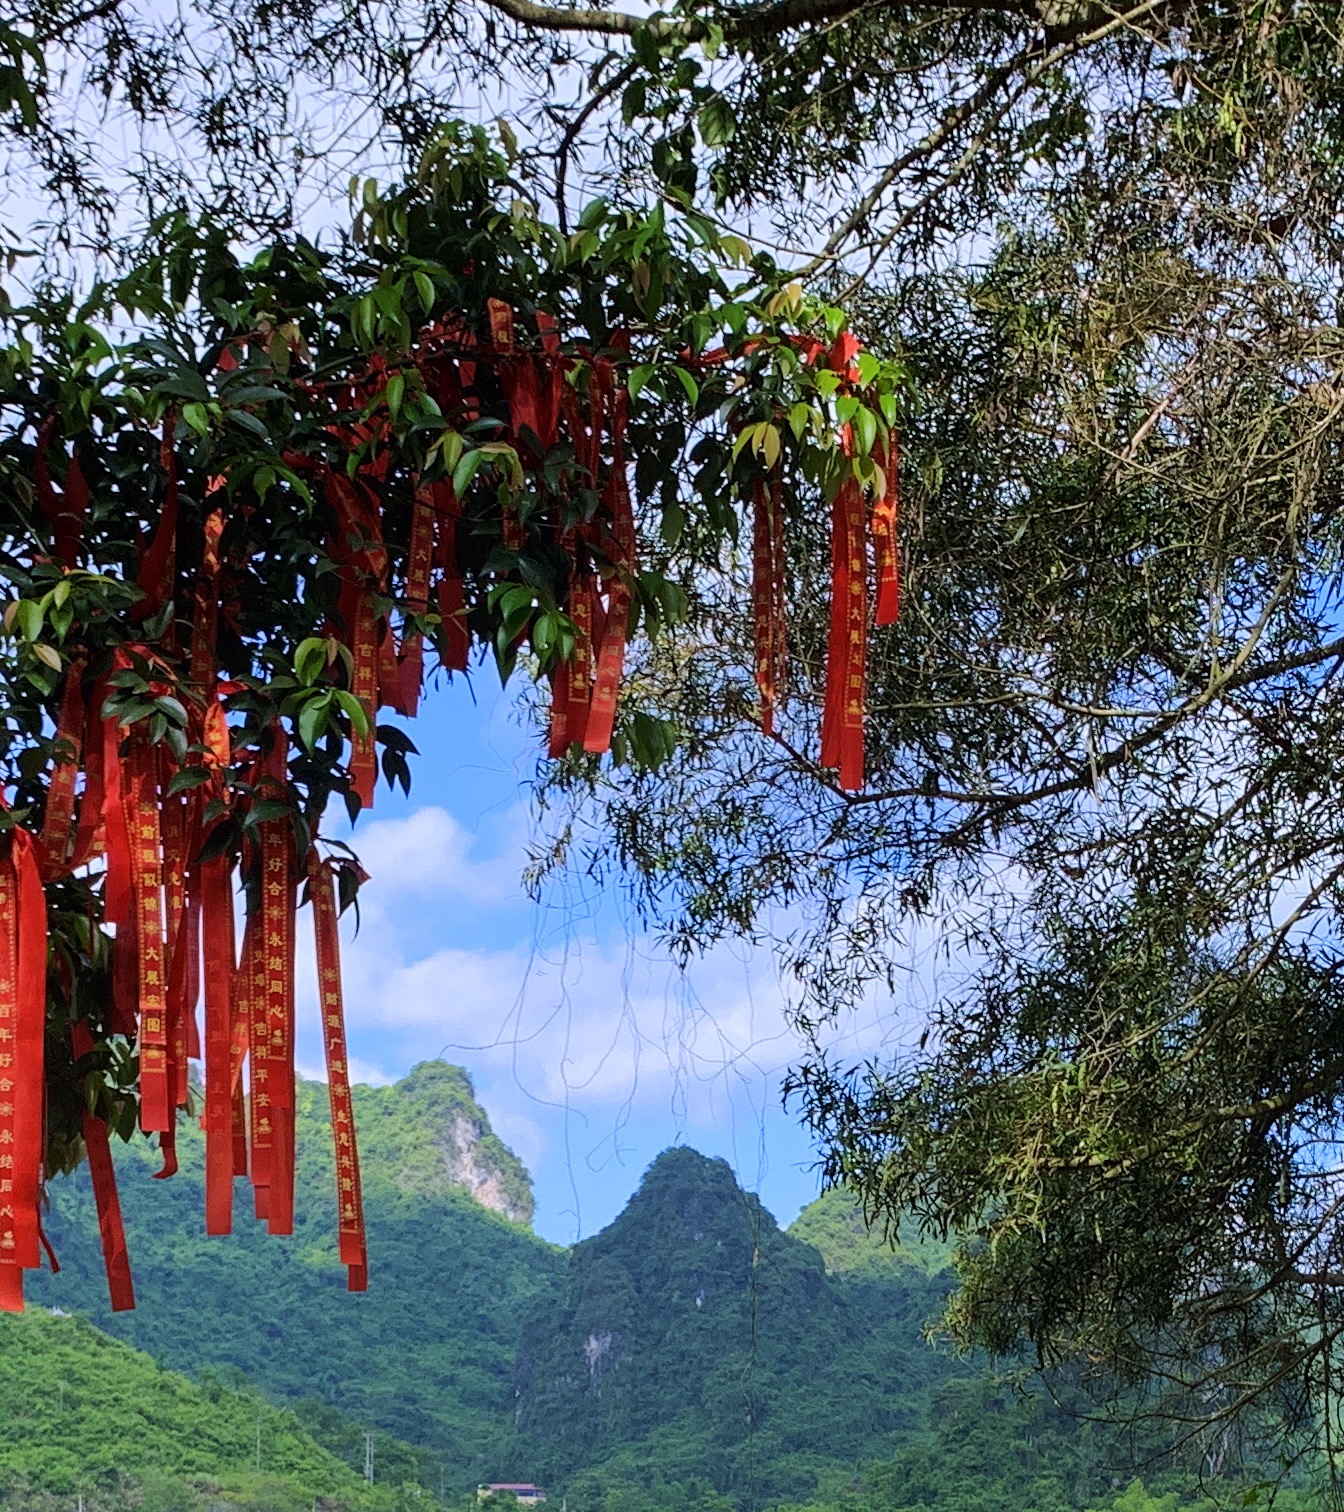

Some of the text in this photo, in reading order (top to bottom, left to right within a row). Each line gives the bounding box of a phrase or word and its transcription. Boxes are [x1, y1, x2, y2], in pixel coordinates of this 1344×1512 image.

[145, 947, 161, 1033] 大展宏图
[268, 934, 284, 1020] 永结同心
